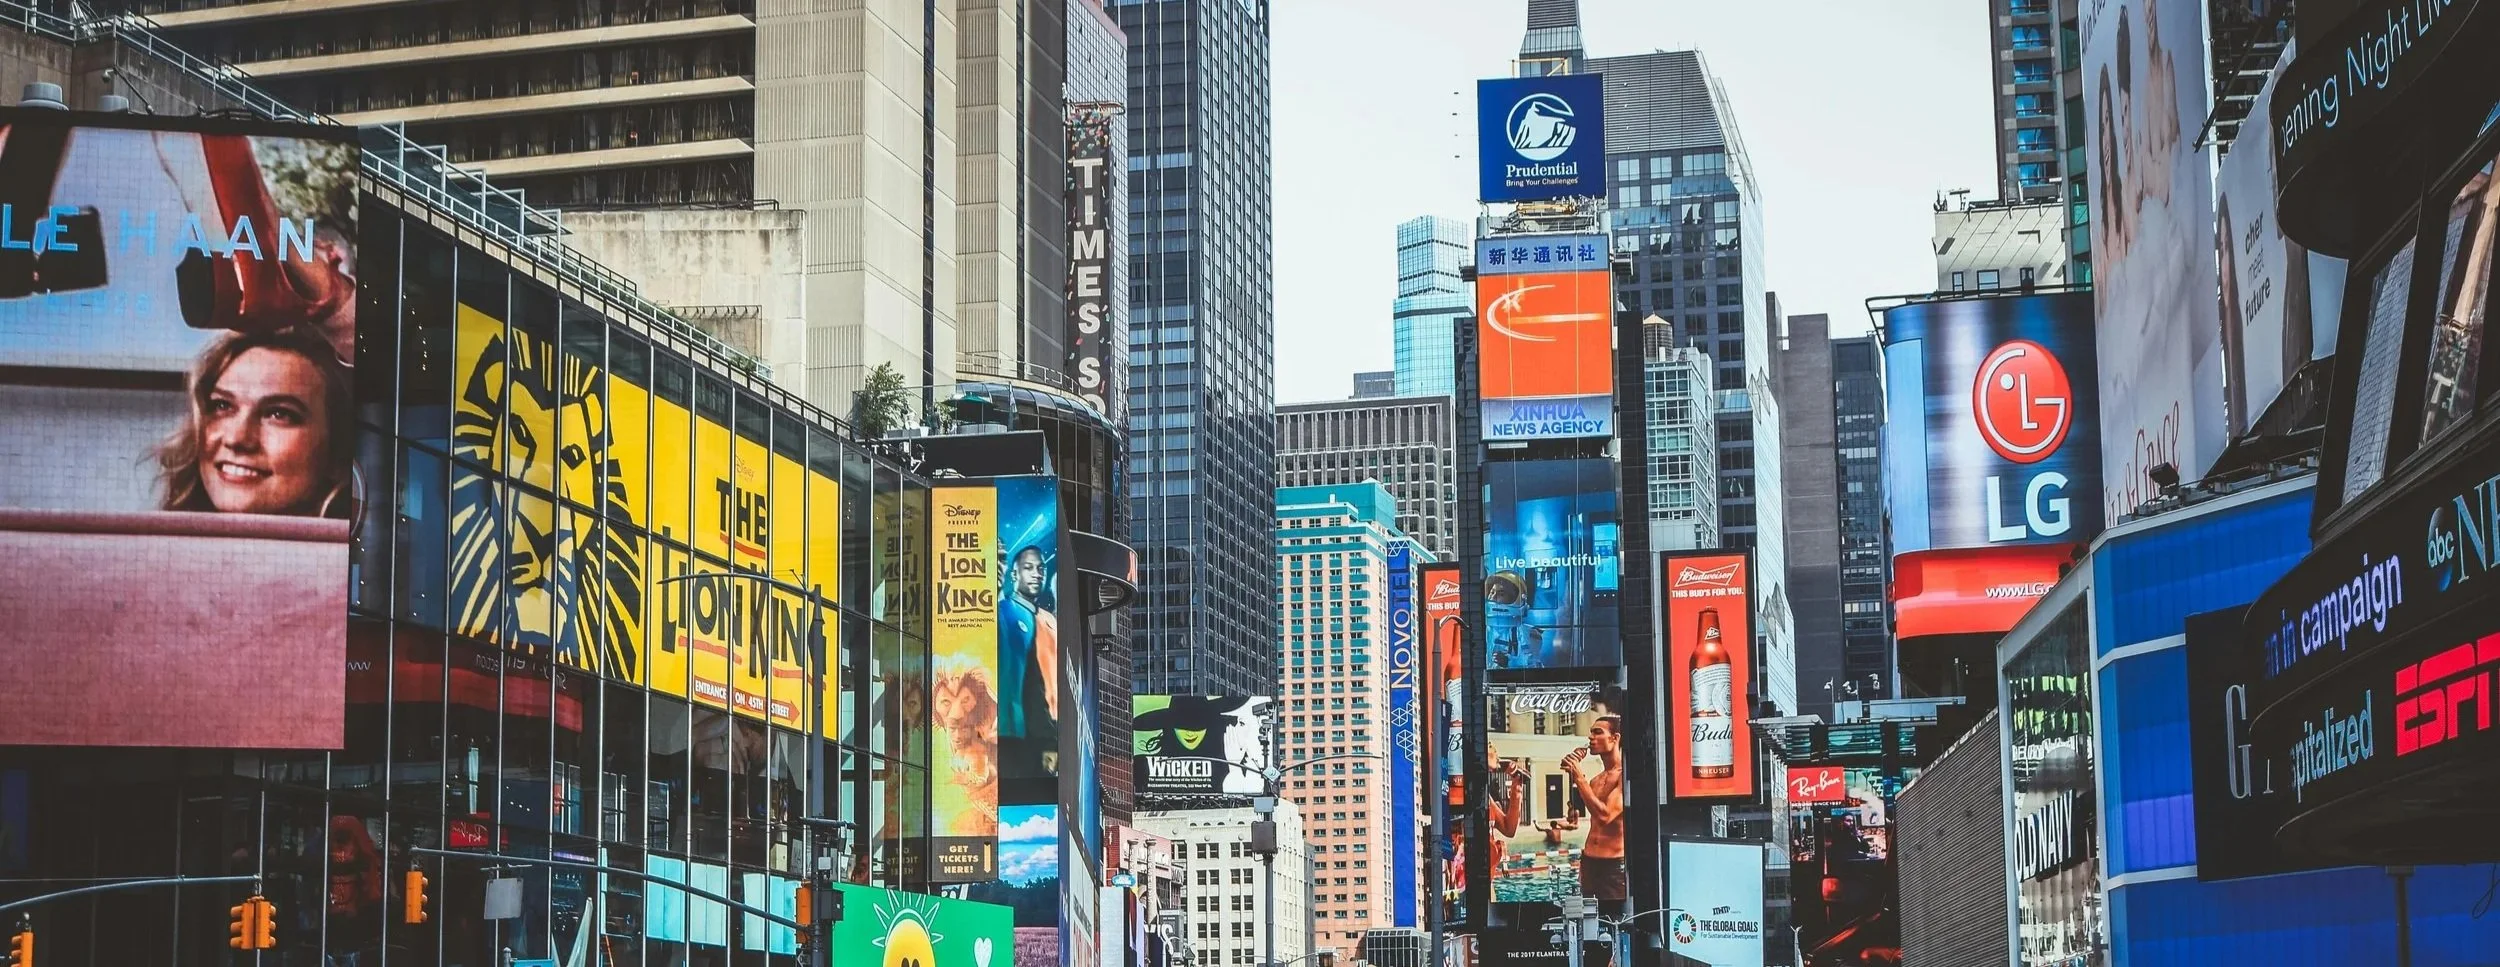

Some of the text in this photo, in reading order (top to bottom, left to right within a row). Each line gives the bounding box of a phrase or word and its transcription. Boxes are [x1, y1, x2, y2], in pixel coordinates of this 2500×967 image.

[2346, 6, 2411, 96] Night
[2416, 0, 2451, 37] Liv
[1505, 161, 1578, 178] Prudential
[1506, 176, 1578, 188] Bring Your Challenges
[117, 208, 315, 263] HAAN
[1072, 157, 1105, 334] TIMES
[2245, 211, 2264, 255] cher
[1488, 243, 1596, 266] 新华通讯社
[2245, 276, 2271, 327] future
[1509, 403, 1587, 421] XINHUA
[1492, 420, 1604, 436] NEWS AGENCY
[716, 477, 767, 547] THE
[942, 504, 981, 520] Disney
[1986, 471, 2072, 543] LG
[945, 532, 979, 549] THE
[2427, 528, 2455, 568] abc
[940, 552, 987, 580] LION
[1495, 553, 1601, 569] Live beautiful
[661, 525, 742, 654] LION
[1680, 570, 1732, 582] Budweiser
[937, 582, 994, 615] KING
[1427, 601, 1460, 611] THIS BUD
[1672, 586, 1745, 599] THIS BUD'S FOR YOU.
[1391, 555, 1411, 690] NOVOTEL
[2282, 608, 2297, 670] in
[2301, 553, 2403, 655] campaign
[695, 683, 790, 718] ENTRANCE ON 45TH STREET
[1790, 769, 1841, 798] Ray-Ban
[949, 845, 969, 853] GET
[2014, 789, 2073, 883] OLD NAVY
[939, 854, 979, 863] TICKETS
[943, 865, 974, 874] HERE!
[1700, 919, 1759, 933] THE GLOBAL GOALS
